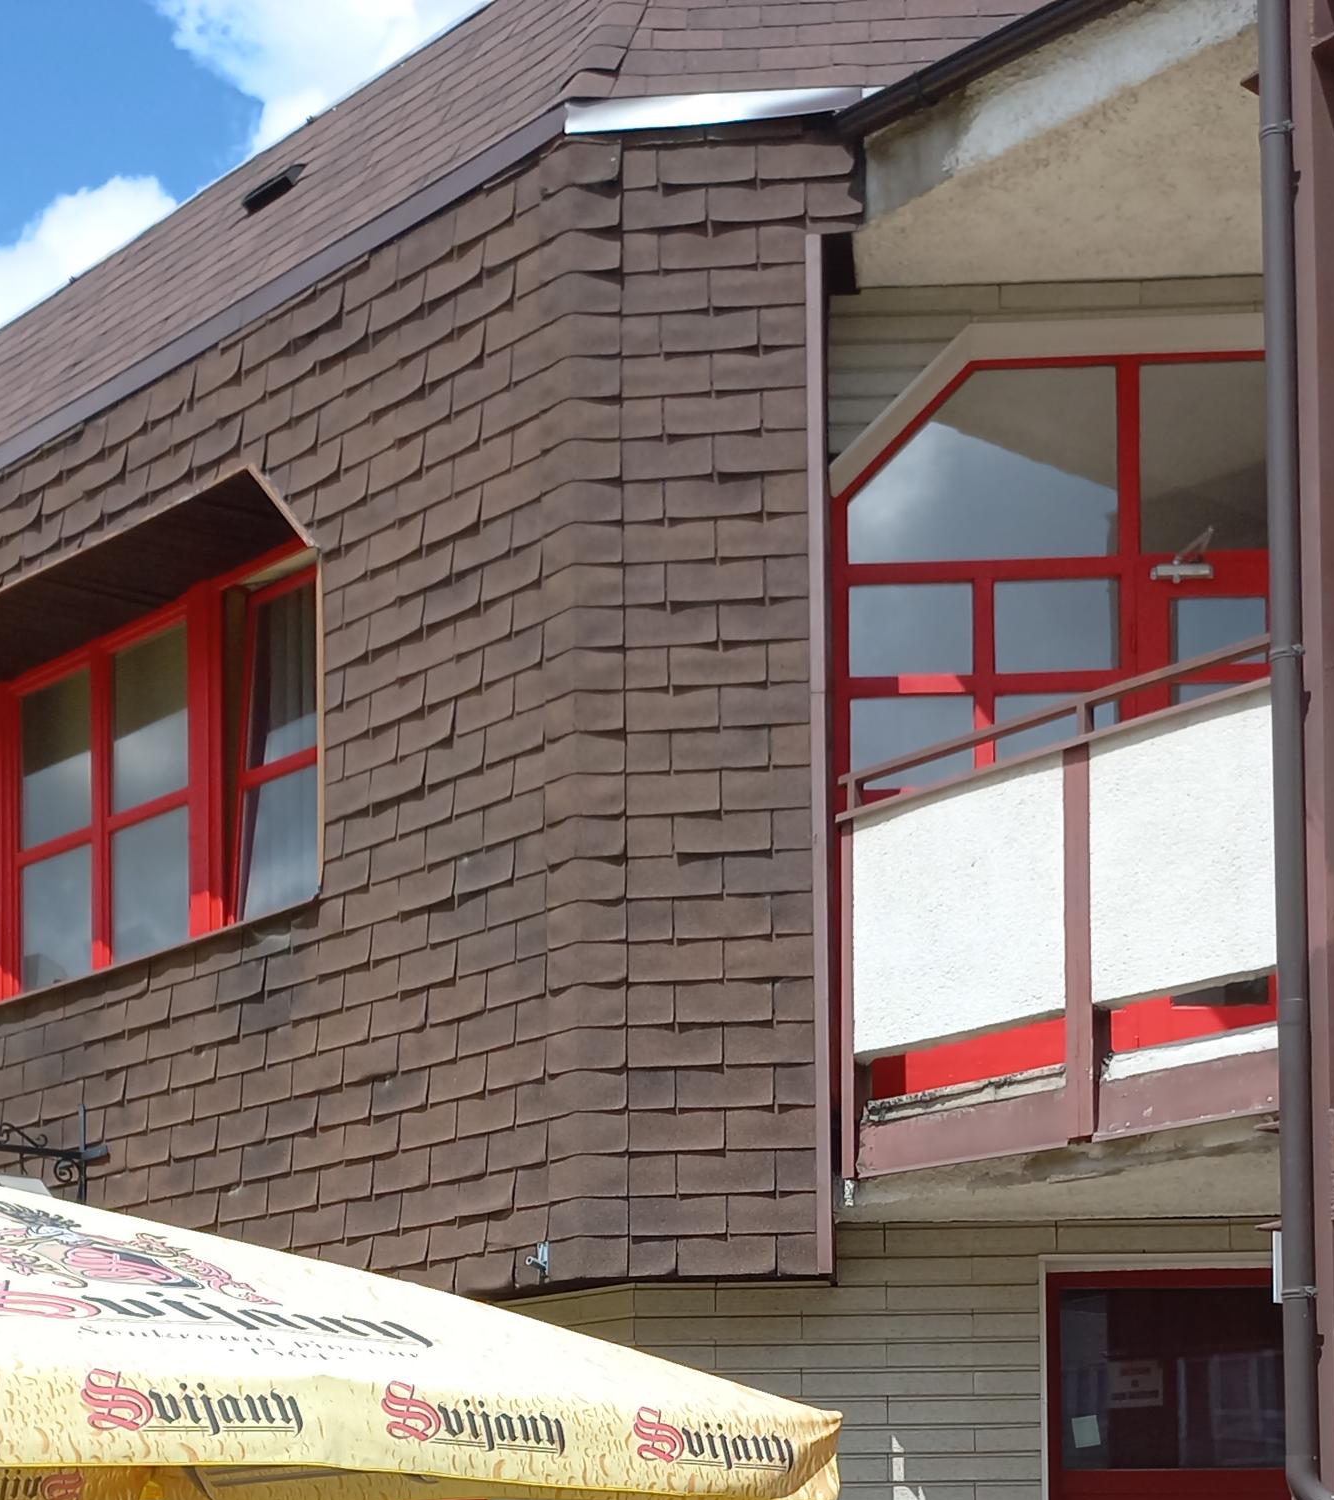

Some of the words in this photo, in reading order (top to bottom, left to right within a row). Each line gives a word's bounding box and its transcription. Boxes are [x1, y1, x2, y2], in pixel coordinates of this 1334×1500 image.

[80, 1367, 304, 1438] Svijany
[381, 1380, 567, 1458] Svijany
[633, 1406, 795, 1474] Svijany
